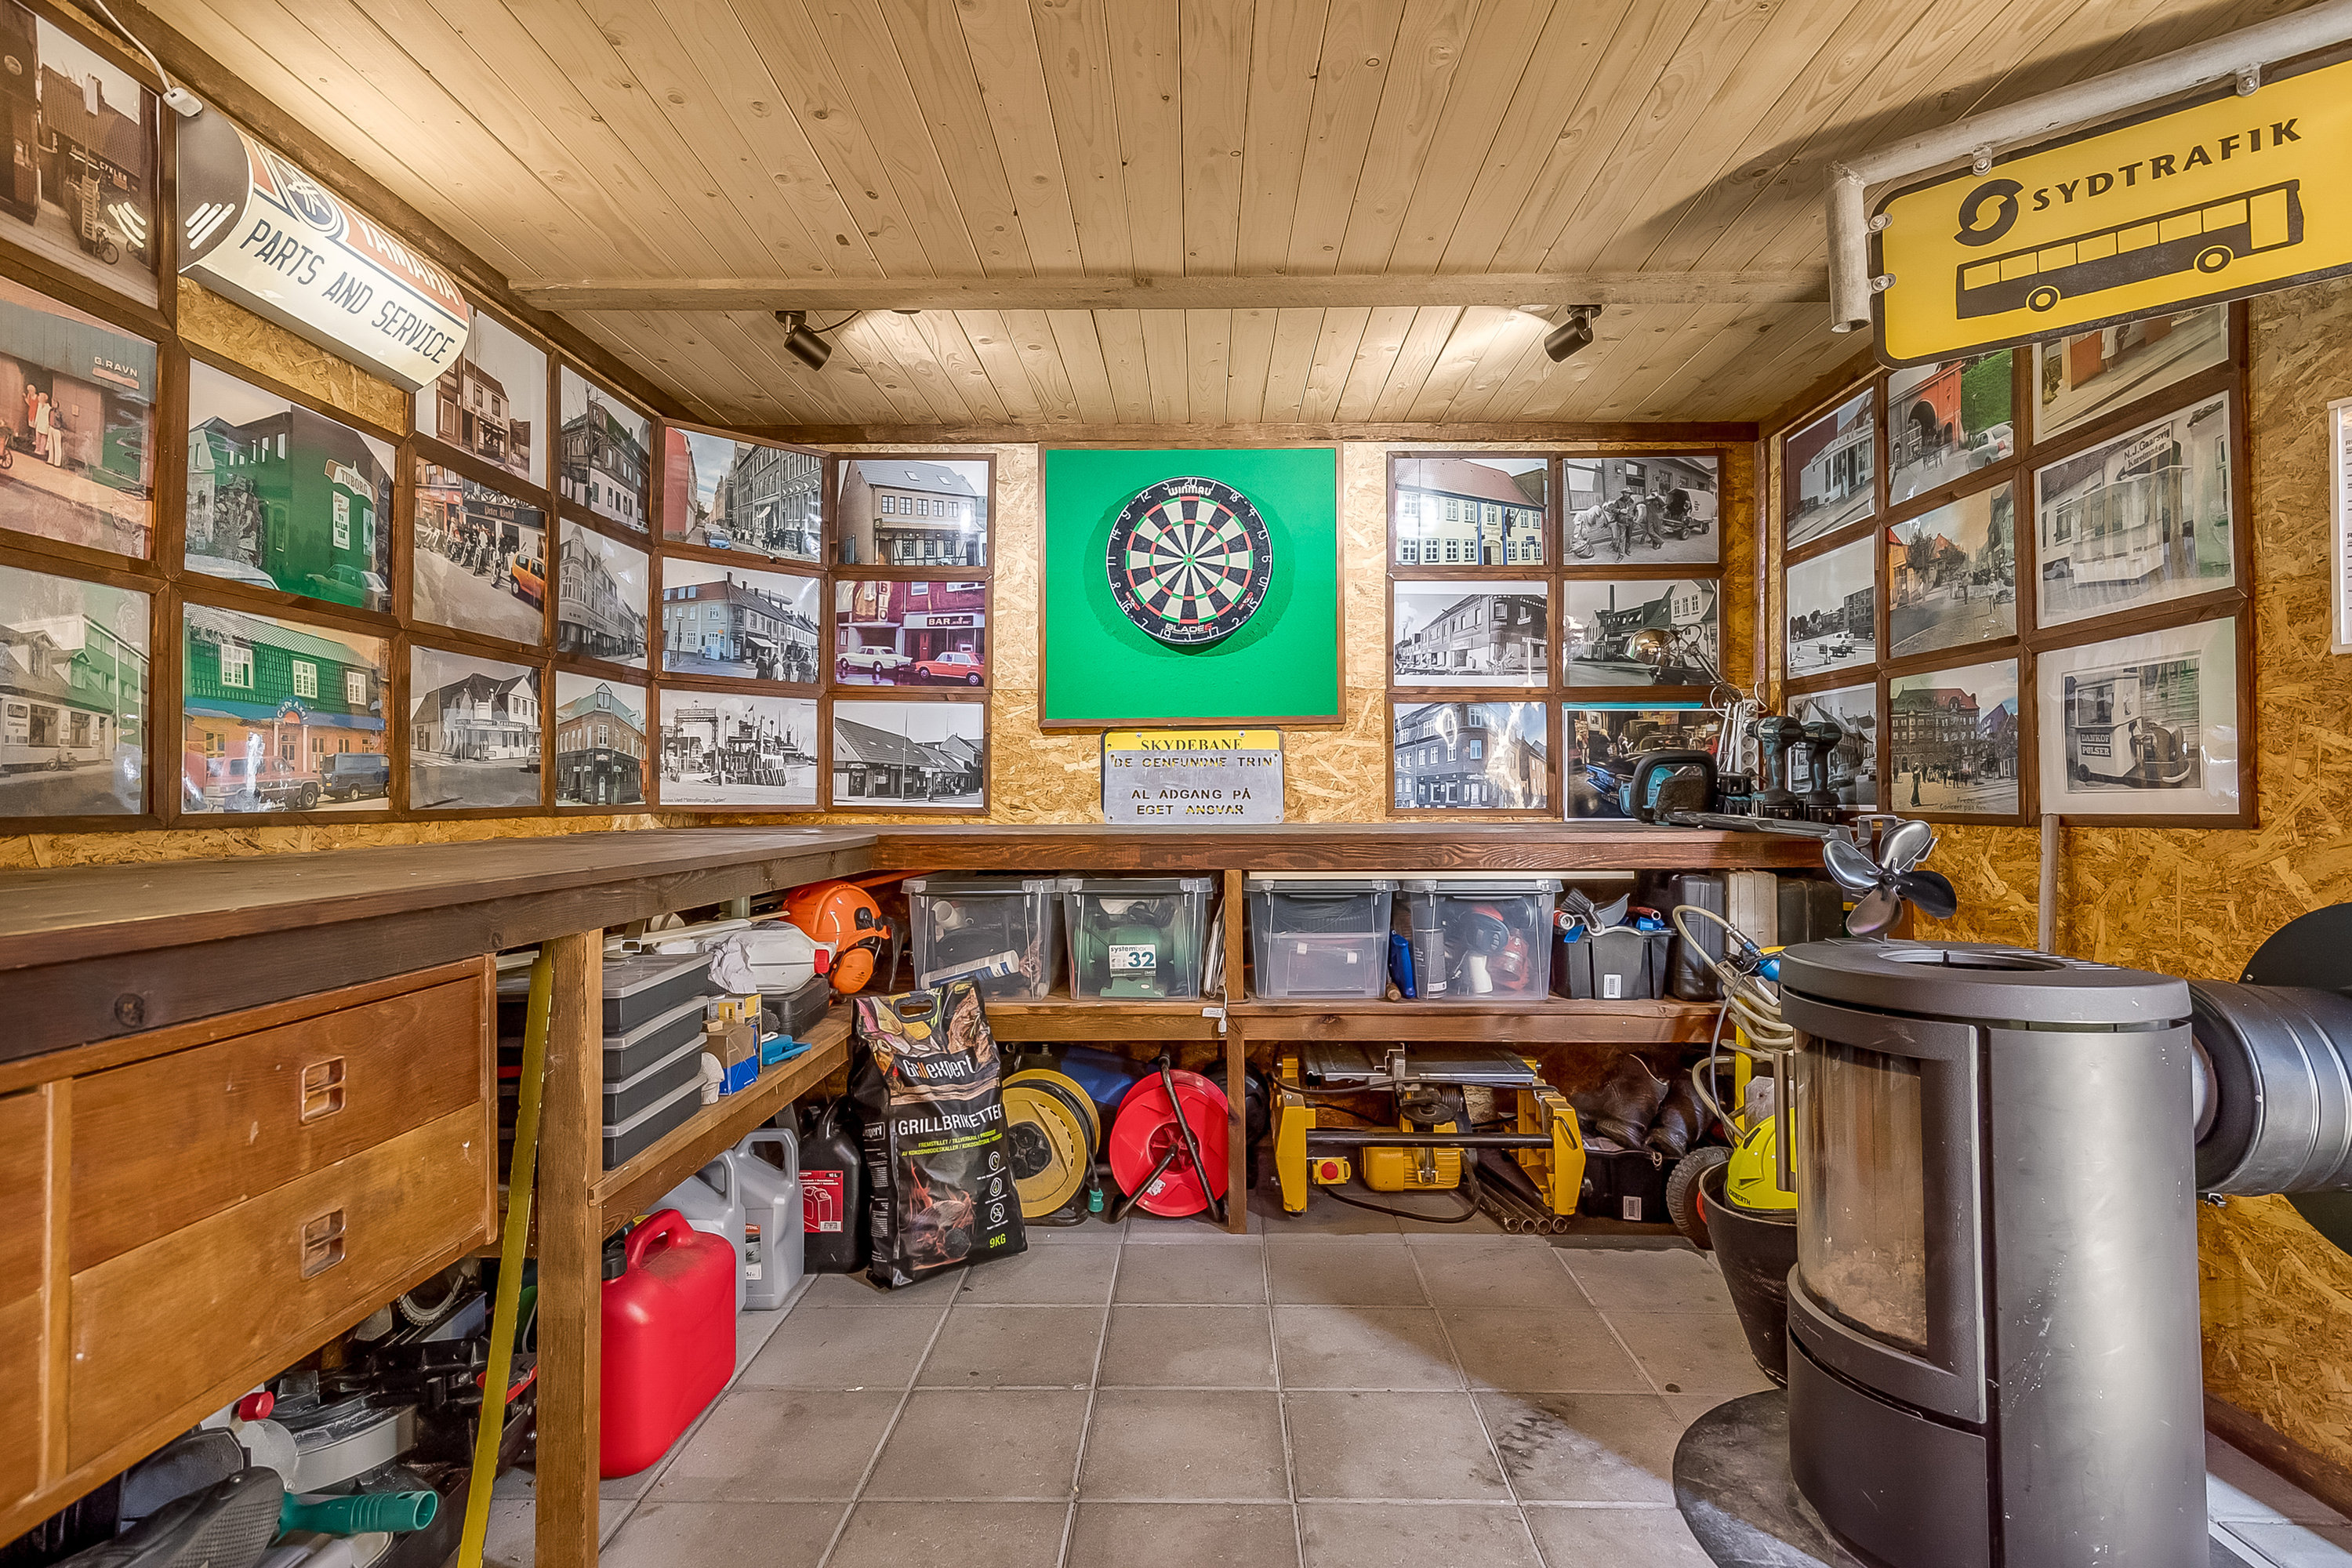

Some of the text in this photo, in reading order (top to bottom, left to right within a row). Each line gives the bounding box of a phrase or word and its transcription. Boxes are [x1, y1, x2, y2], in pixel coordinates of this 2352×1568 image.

[2032, 118, 2302, 212] SYDTRAFIK
[349, 210, 460, 307] YAMAHA
[238, 218, 456, 365] PARTS AND SERVICE
[340, 469, 368, 495] TUBORG
[1163, 481, 1170, 491] 5
[1184, 477, 1197, 488] 20
[1137, 489, 1152, 503] 12
[1168, 485, 1211, 496] WINMAU
[1229, 488, 1243, 503] 18
[1121, 508, 1131, 521] 9
[1248, 507, 1256, 517] 4
[1109, 527, 1122, 542] 14
[1261, 555, 1272, 564] 6
[1258, 576, 1269, 591] 10
[879, 581, 888, 621] BIO
[1120, 598, 1133, 616] 16
[1247, 597, 1259, 612] 15
[928, 618, 951, 626] BAR
[1140, 617, 1149, 628] 7
[1232, 617, 1241, 626] 2
[1157, 628, 1171, 639] 19
[1207, 626, 1220, 639] 17
[293, 701, 308, 720] Axel
[1141, 739, 1243, 750] SKYDEBANE
[2081, 734, 2110, 742] DANKOF
[2082, 746, 2111, 756] PØLSER
[1114, 757, 1133, 768] DE
[1237, 757, 1272, 767] TRIN
[1131, 787, 1251, 800] AL ADGANG PÅ
[1137, 804, 1244, 815] EGET ANSVAR
[1128, 951, 1155, 967] 32
[902, 1054, 976, 1080] Grillexpert
[989, 1233, 1006, 1249] 9KG
